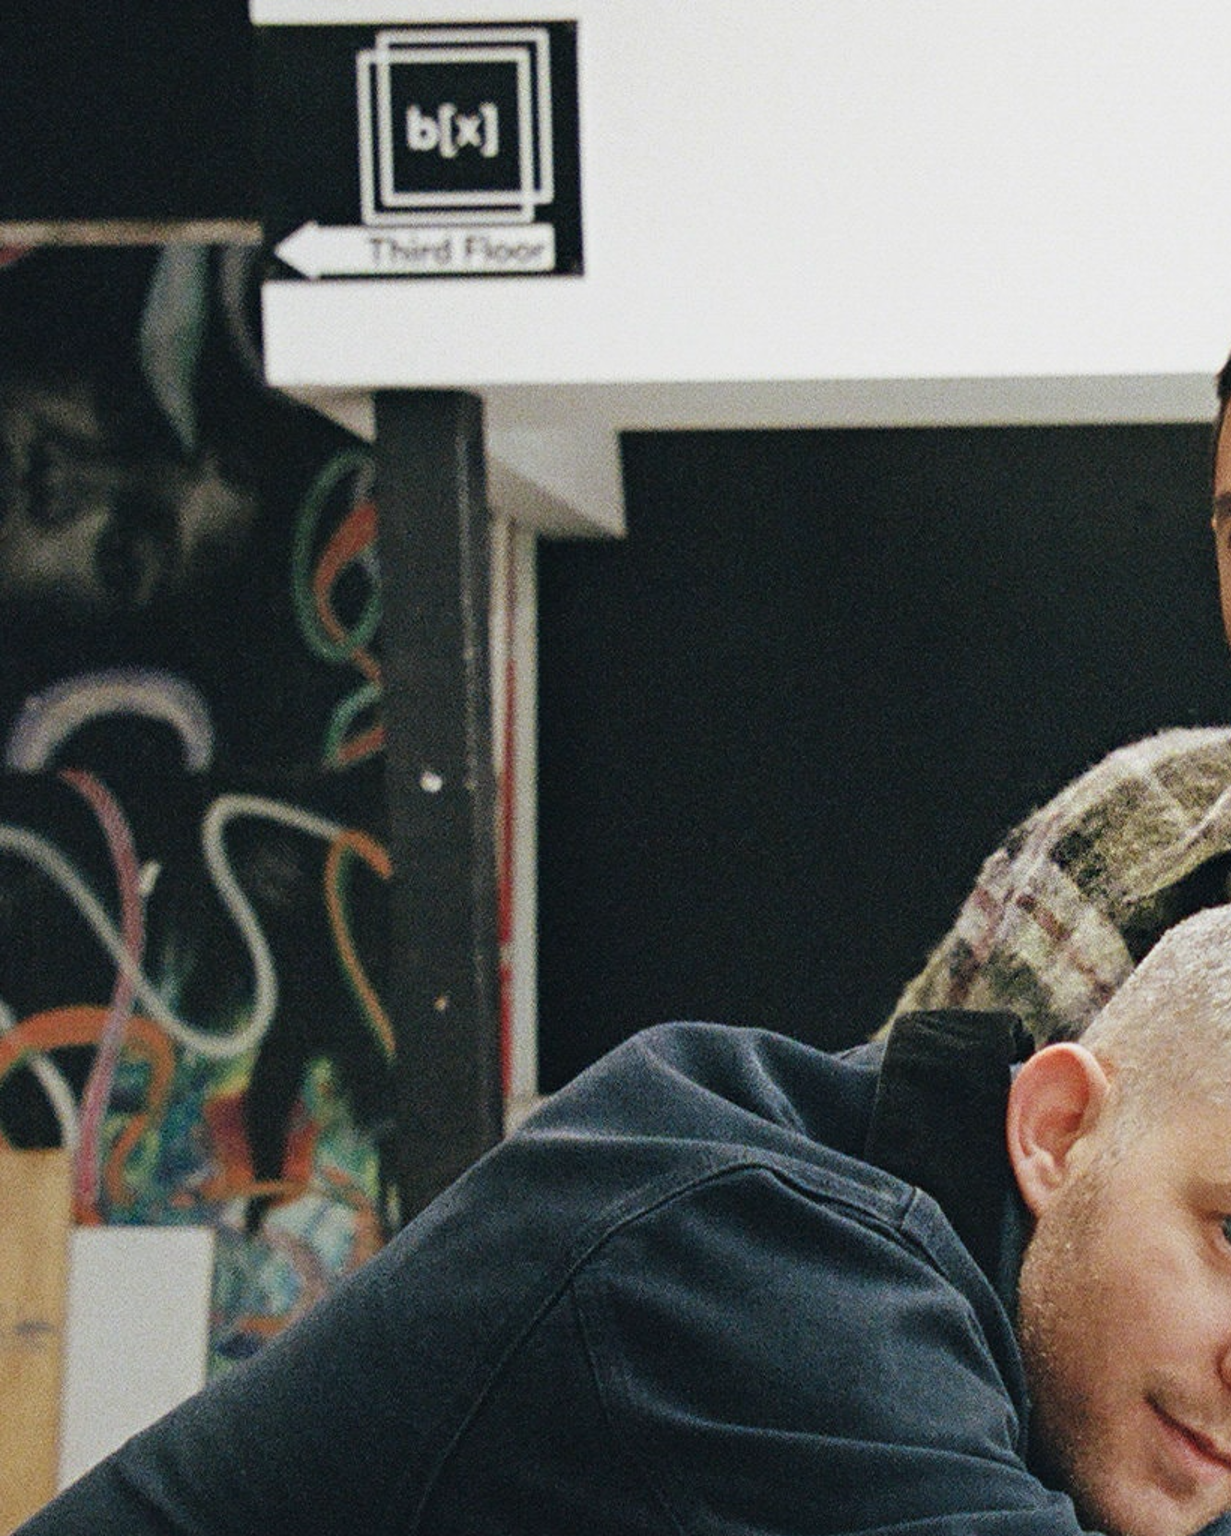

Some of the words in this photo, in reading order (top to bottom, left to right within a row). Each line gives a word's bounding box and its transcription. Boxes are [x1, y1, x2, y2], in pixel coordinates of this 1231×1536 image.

[406, 103, 498, 158] b[x]
[370, 237, 453, 264] Third
[464, 235, 546, 262] Floor
